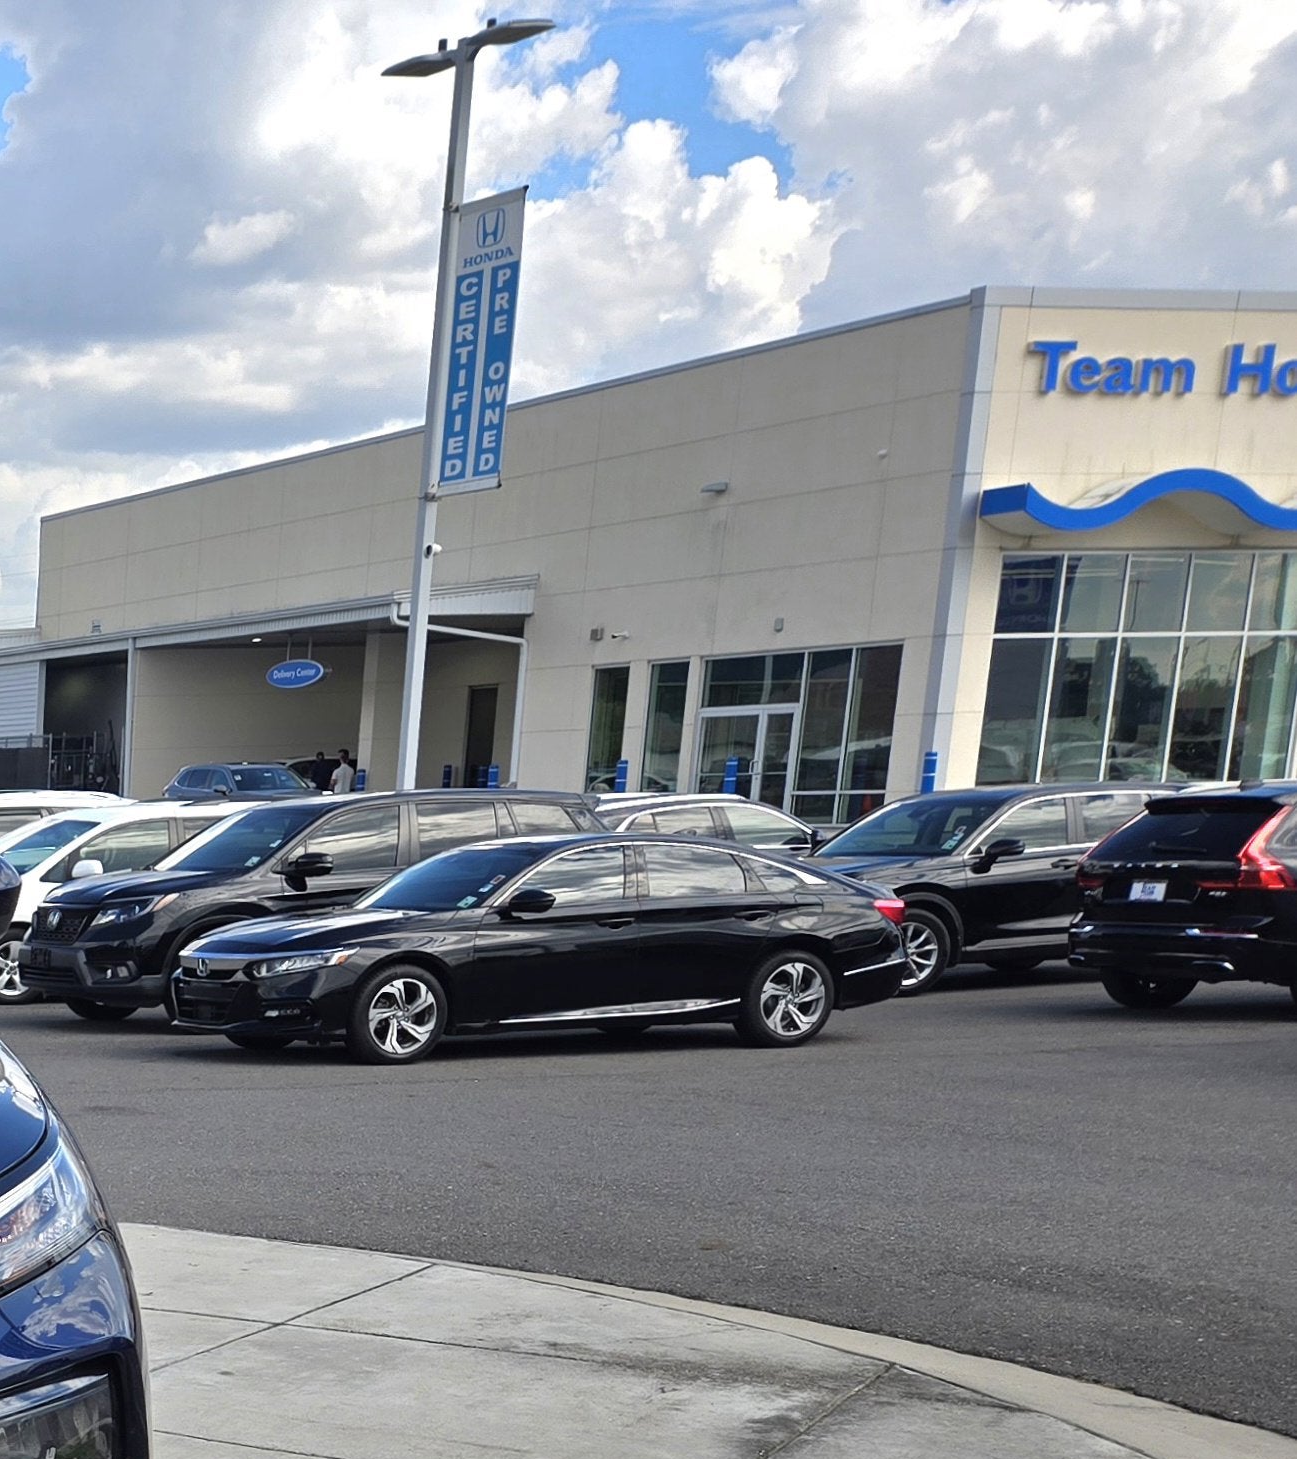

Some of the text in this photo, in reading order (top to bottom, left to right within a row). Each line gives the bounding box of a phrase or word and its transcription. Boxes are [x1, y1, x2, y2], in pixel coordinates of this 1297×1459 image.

[462, 247, 515, 268] HONDA
[445, 277, 479, 477] CERTIFIED
[478, 268, 512, 472] PRE OWNED
[1029, 341, 1297, 396] Team Ho
[273, 667, 316, 680] Delivery Center
